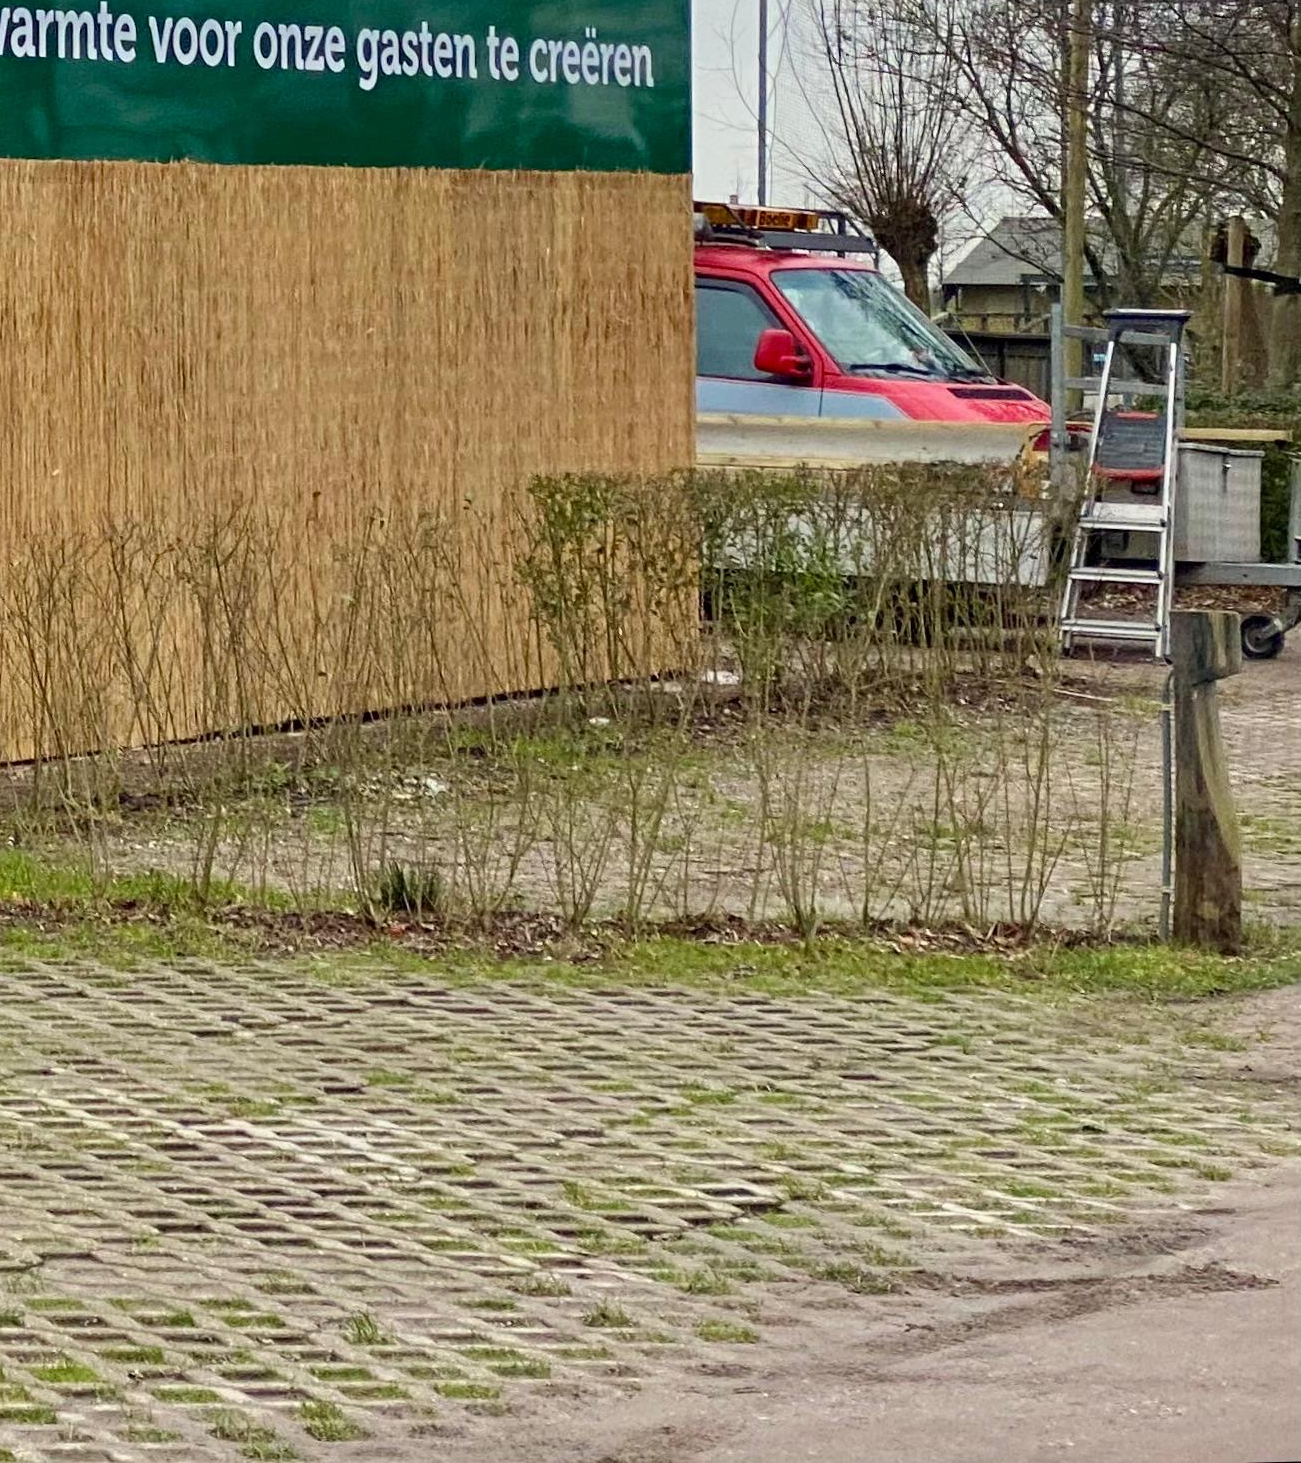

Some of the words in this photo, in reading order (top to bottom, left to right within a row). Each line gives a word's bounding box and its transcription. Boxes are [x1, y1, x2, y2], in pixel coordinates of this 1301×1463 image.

[148, 16, 242, 67] voor
[253, 22, 346, 73] onze
[356, 21, 478, 91] gasten
[486, 25, 520, 81] te
[529, 27, 654, 87] creëren
